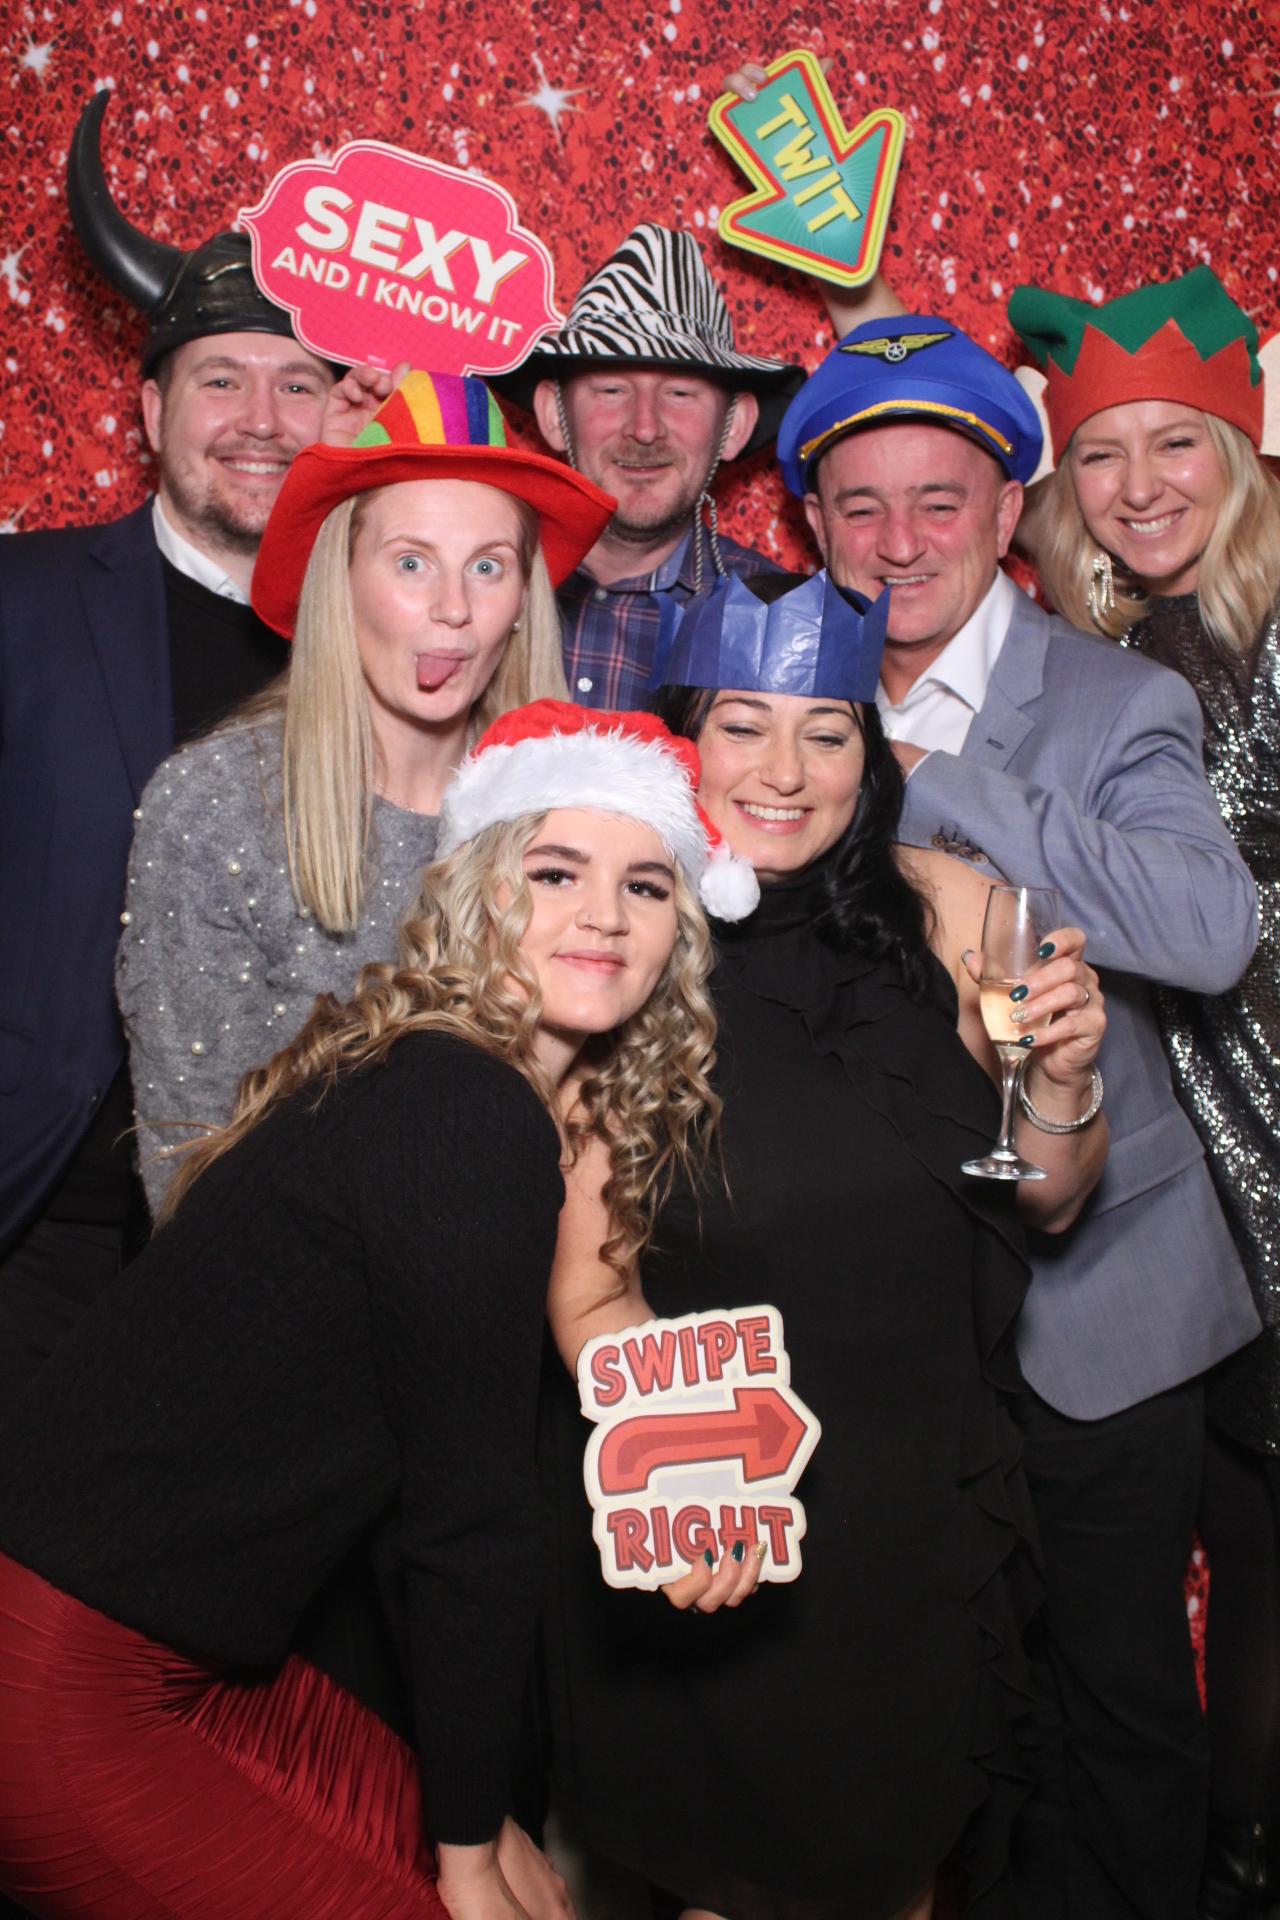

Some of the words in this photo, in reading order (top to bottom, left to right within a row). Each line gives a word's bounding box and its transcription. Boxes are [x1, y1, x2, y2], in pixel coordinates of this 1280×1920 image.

[756, 93, 863, 233] TWIT
[295, 185, 530, 305] SEXY
[271, 246, 350, 290] AND
[355, 272, 369, 297] I
[373, 278, 486, 334] KNOW
[487, 316, 523, 346] IT
[590, 1316, 777, 1407] SWIPE
[607, 1504, 794, 1572] RIGHT
